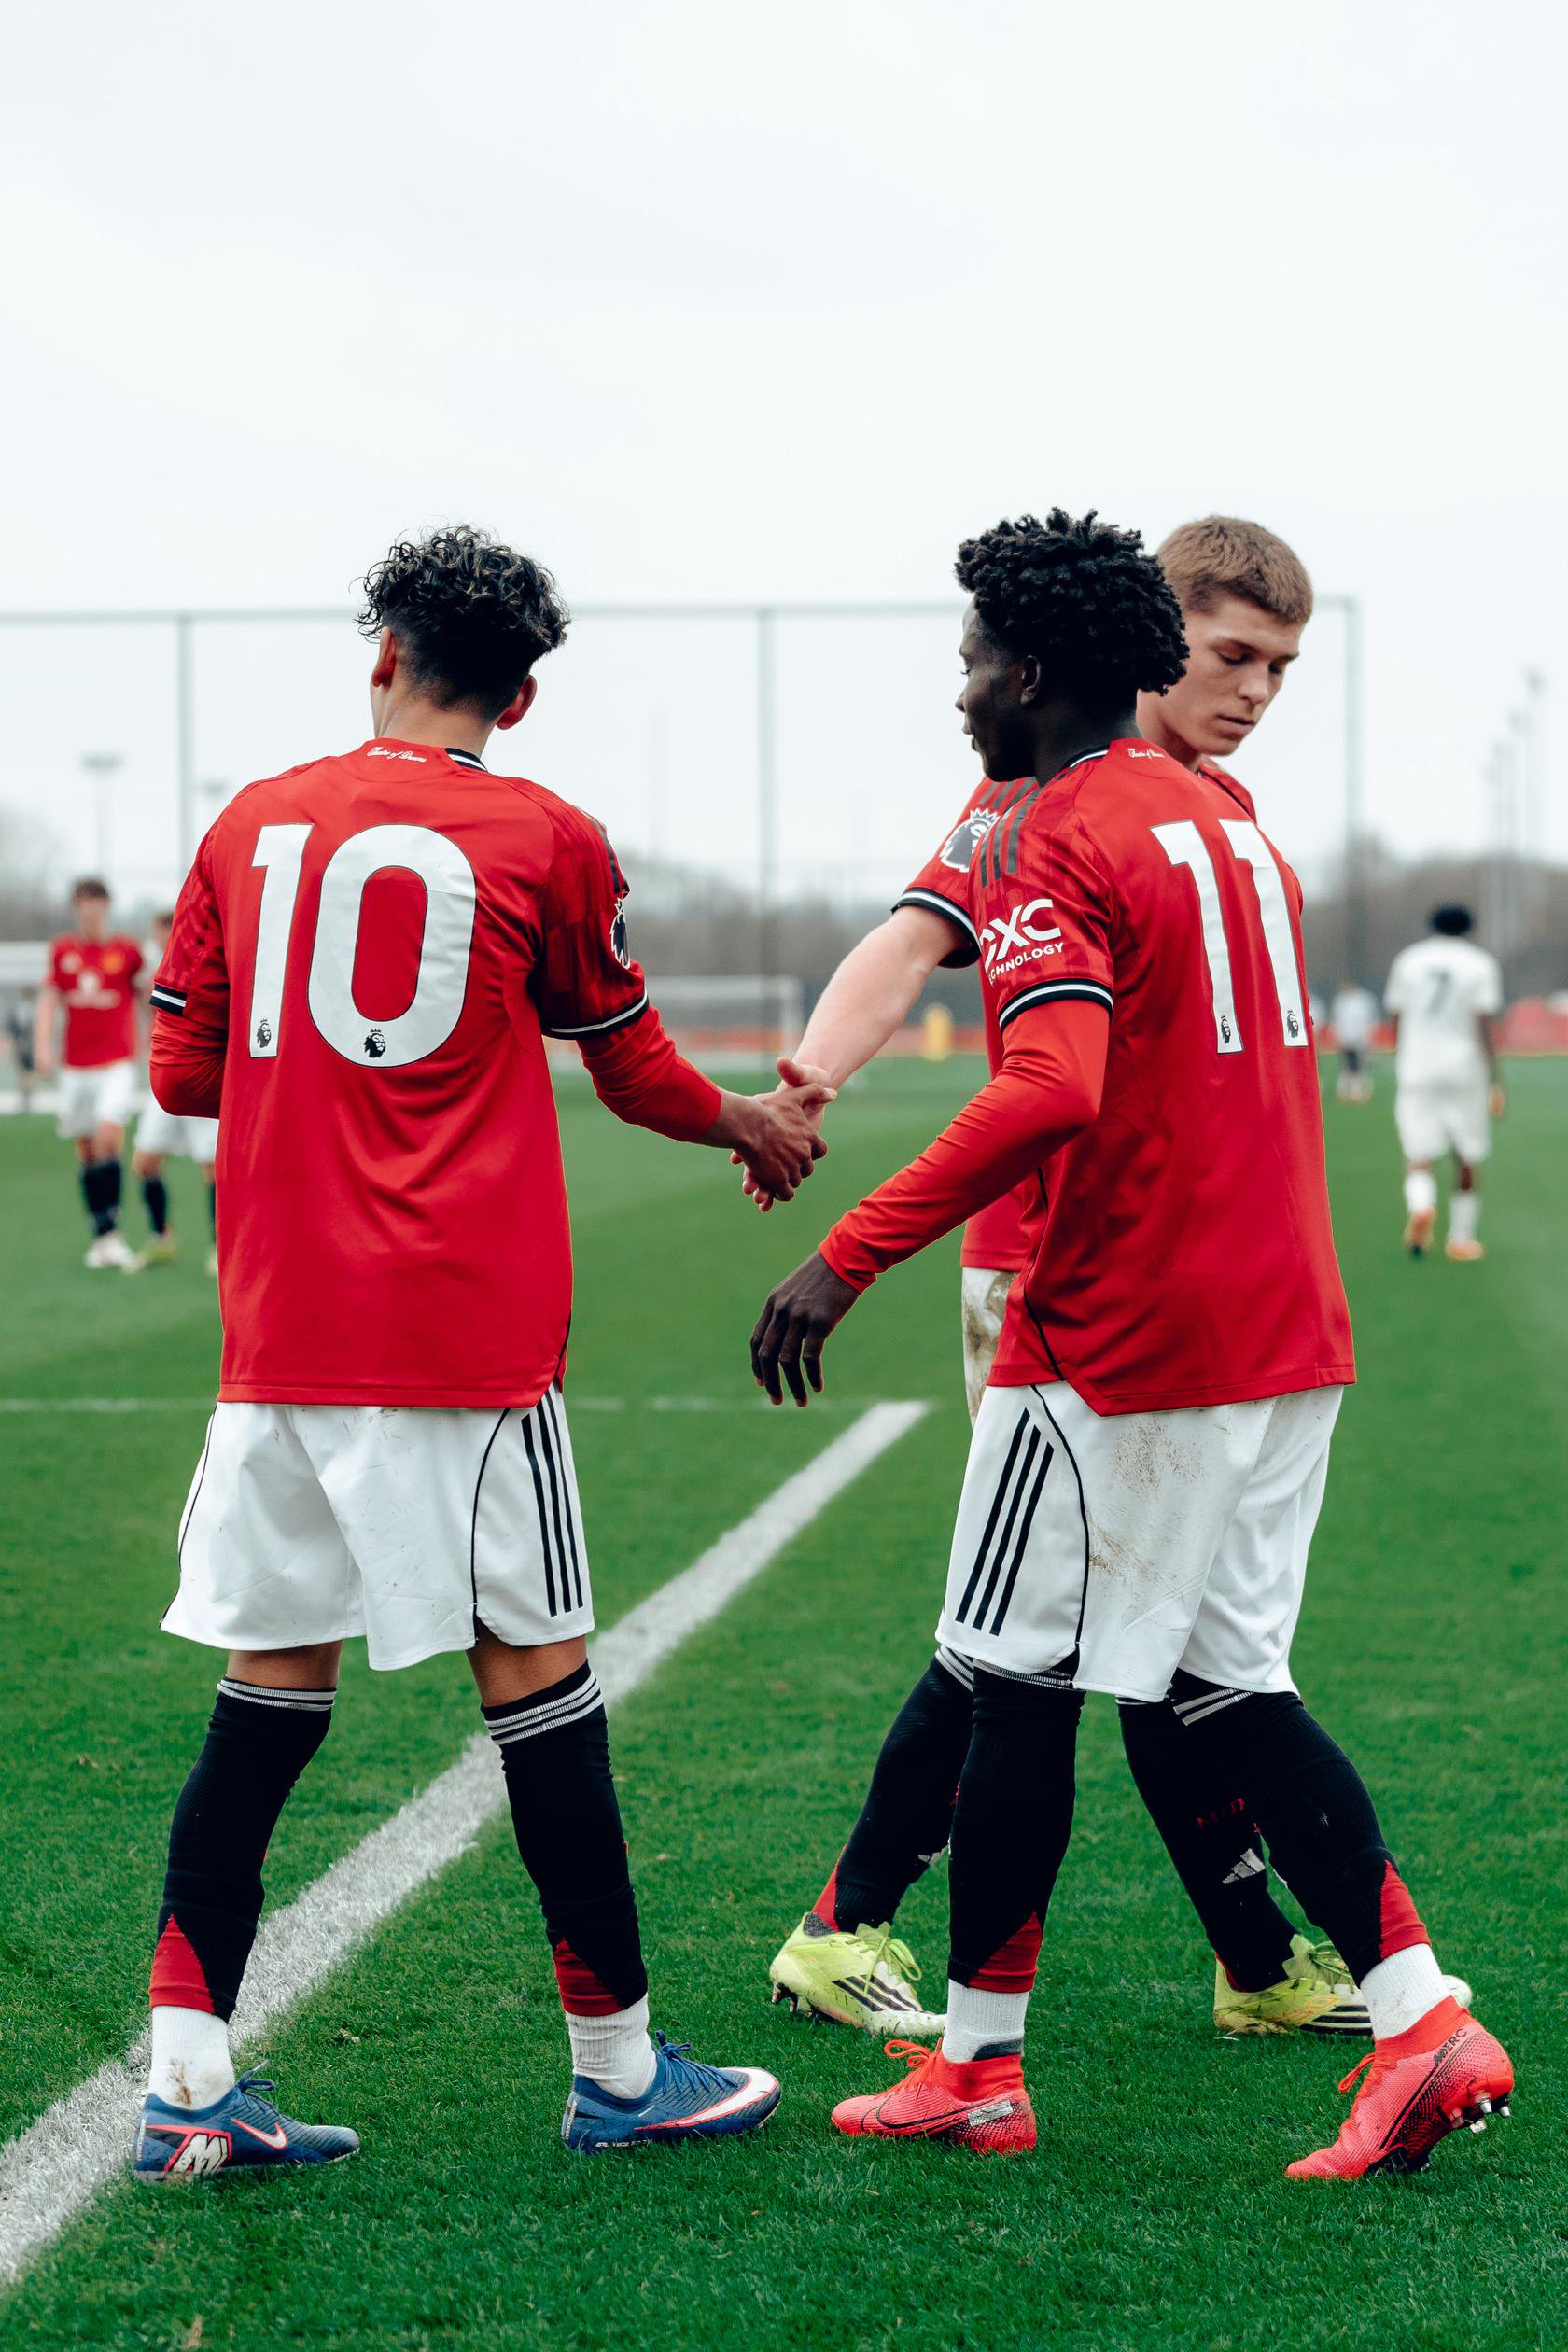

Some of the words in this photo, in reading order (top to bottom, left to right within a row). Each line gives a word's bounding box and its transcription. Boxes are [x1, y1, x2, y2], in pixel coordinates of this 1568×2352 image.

[248, 822, 478, 1068] 10
[1150, 818, 1309, 1055] 11
[1425, 966, 1453, 1017] 7
